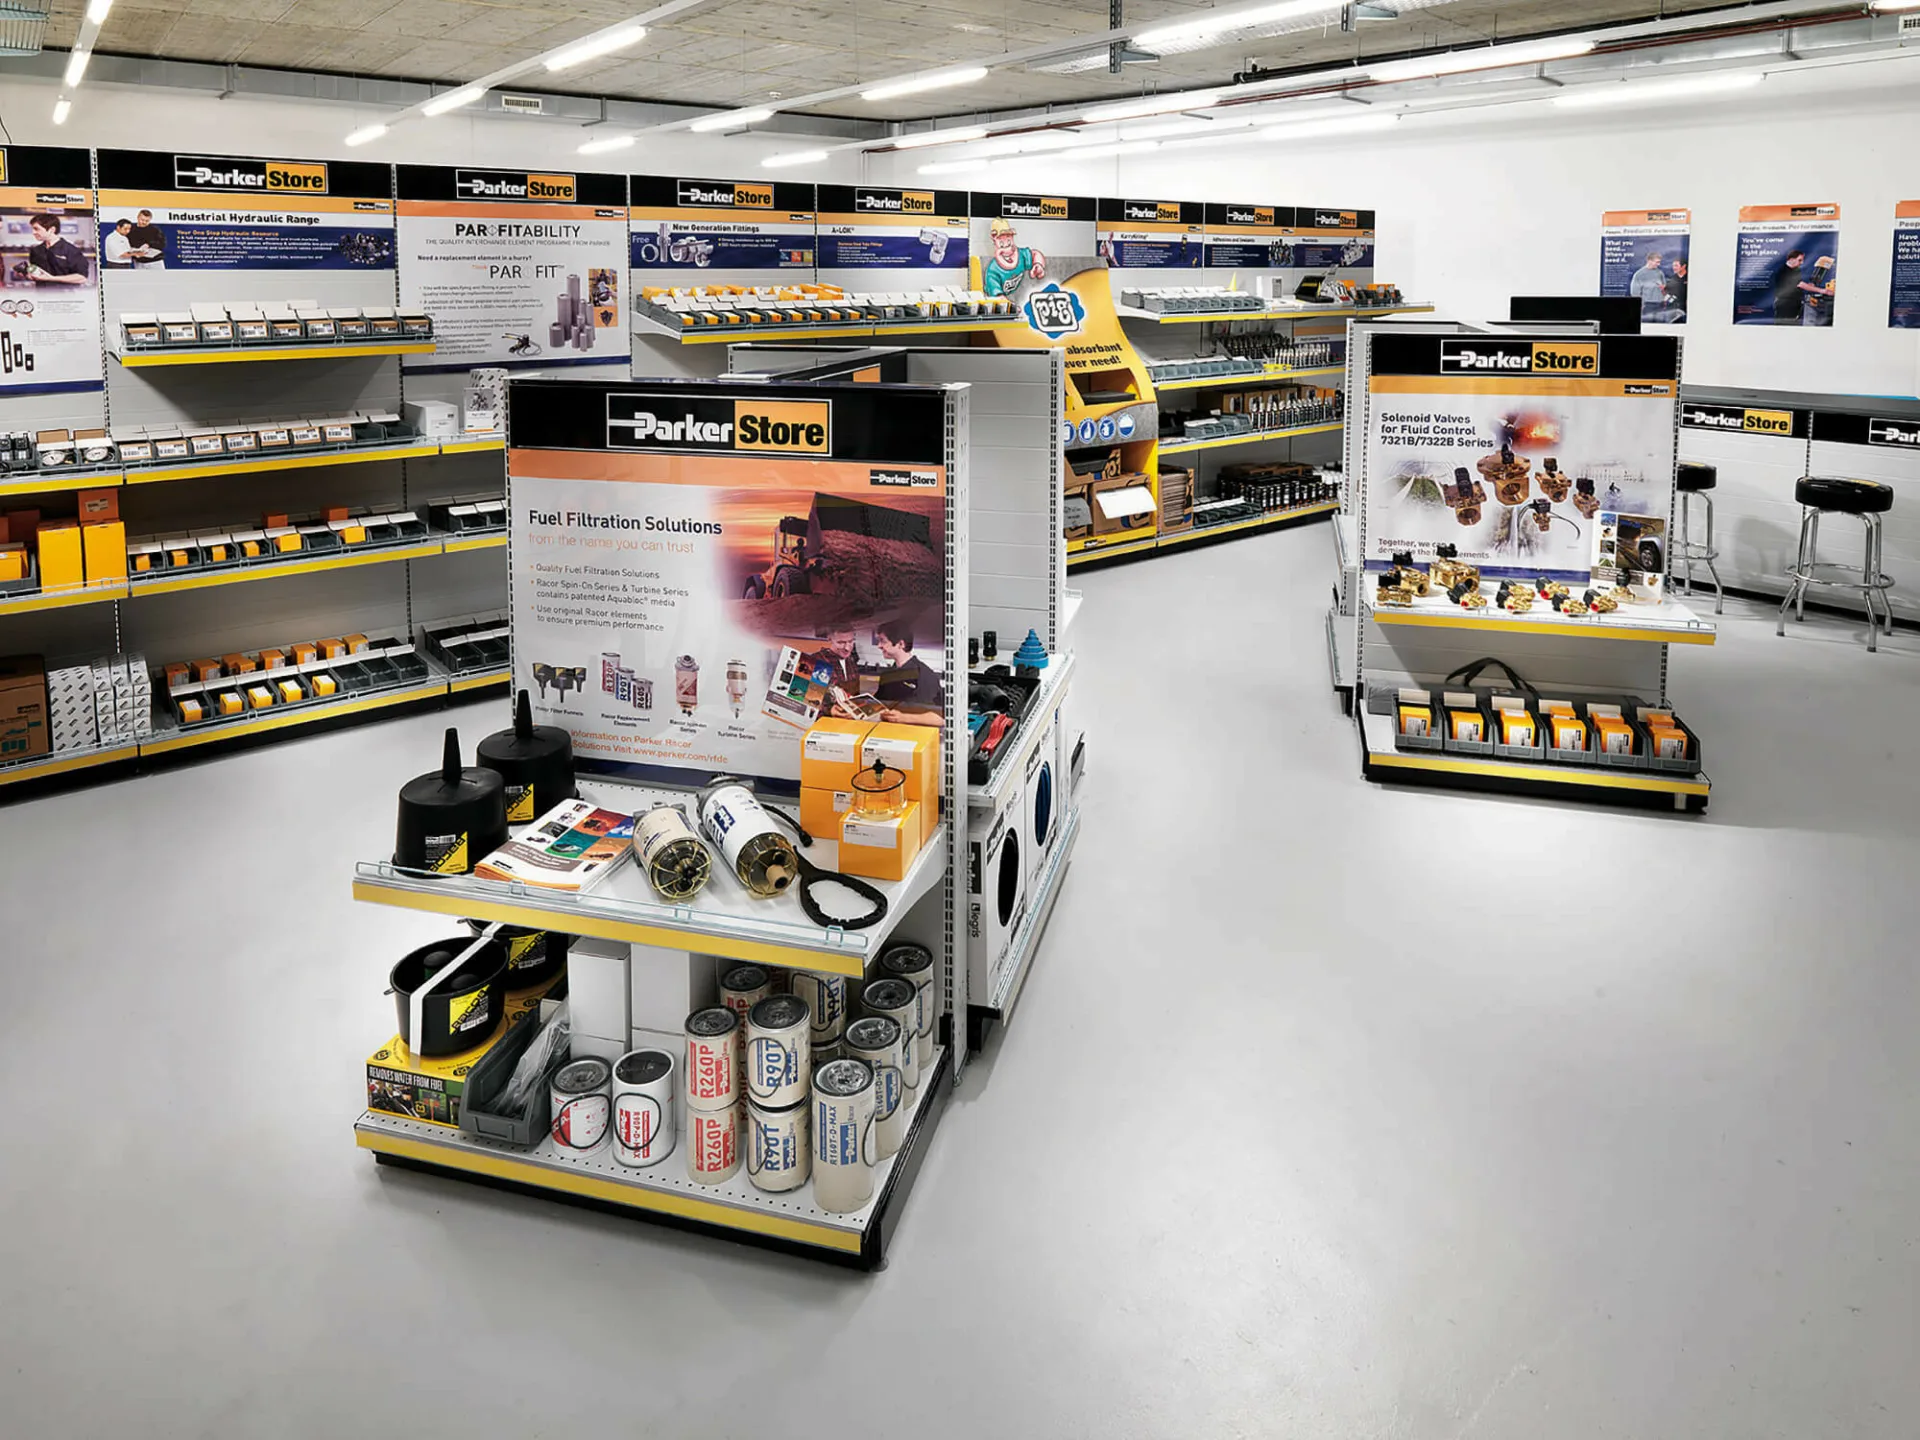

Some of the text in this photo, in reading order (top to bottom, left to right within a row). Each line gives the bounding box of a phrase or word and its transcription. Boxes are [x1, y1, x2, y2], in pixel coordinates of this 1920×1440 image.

[196, 163, 324, 189] Parker Store
[472, 179, 573, 197] Parker Store
[690, 188, 771, 206] Parker Store
[866, 196, 932, 210] Parker Store
[1010, 201, 1066, 216] Parker Store
[1131, 205, 1179, 221] Parker Store
[169, 212, 320, 225] Industrial Hydraulic Range
[1233, 211, 1274, 224] Parker Store
[1321, 214, 1357, 226] Parker Store
[691, 224, 730, 232] Generation
[732, 225, 760, 233] Fittings
[632, 236, 650, 244] Free
[1066, 343, 1122, 355] absorbant
[1091, 355, 1121, 367] need!
[1461, 351, 1595, 369] Parker Store
[1381, 413, 1471, 424] Solenoid Valves
[1695, 411, 1788, 432] Parker Store
[634, 411, 824, 446] Parker Store
[1381, 425, 1476, 436] for Fluid Control
[1381, 436, 1494, 448] 7321B/7322B Series
[879, 474, 937, 486] Parker Store
[529, 510, 723, 535] Fuel Filtration Solutions
[529, 533, 694, 553] from the name you can trust
[1378, 538, 1417, 548] Together,
[536, 563, 660, 580] Quality Fuel Filtration Solutions
[536, 579, 558, 588] Racor
[594, 582, 620, 592] Series
[621, 583, 628, 592] &
[631, 585, 661, 594] Turbine
[663, 587, 689, 597] Series
[536, 590, 569, 599] contains
[571, 592, 606, 602] patented
[650, 597, 676, 607] media
[537, 605, 648, 620] Use original Racor elements
[537, 614, 665, 632] to ensure premium performance
[613, 742, 632, 754] Visit
[634, 735, 663, 746] Parker
[665, 738, 692, 749] Racor
[766, 1040, 782, 1087] R90T
[699, 1045, 714, 1098] R260P
[706, 1119, 721, 1172] R260P
[764, 1123, 780, 1171] R90T
